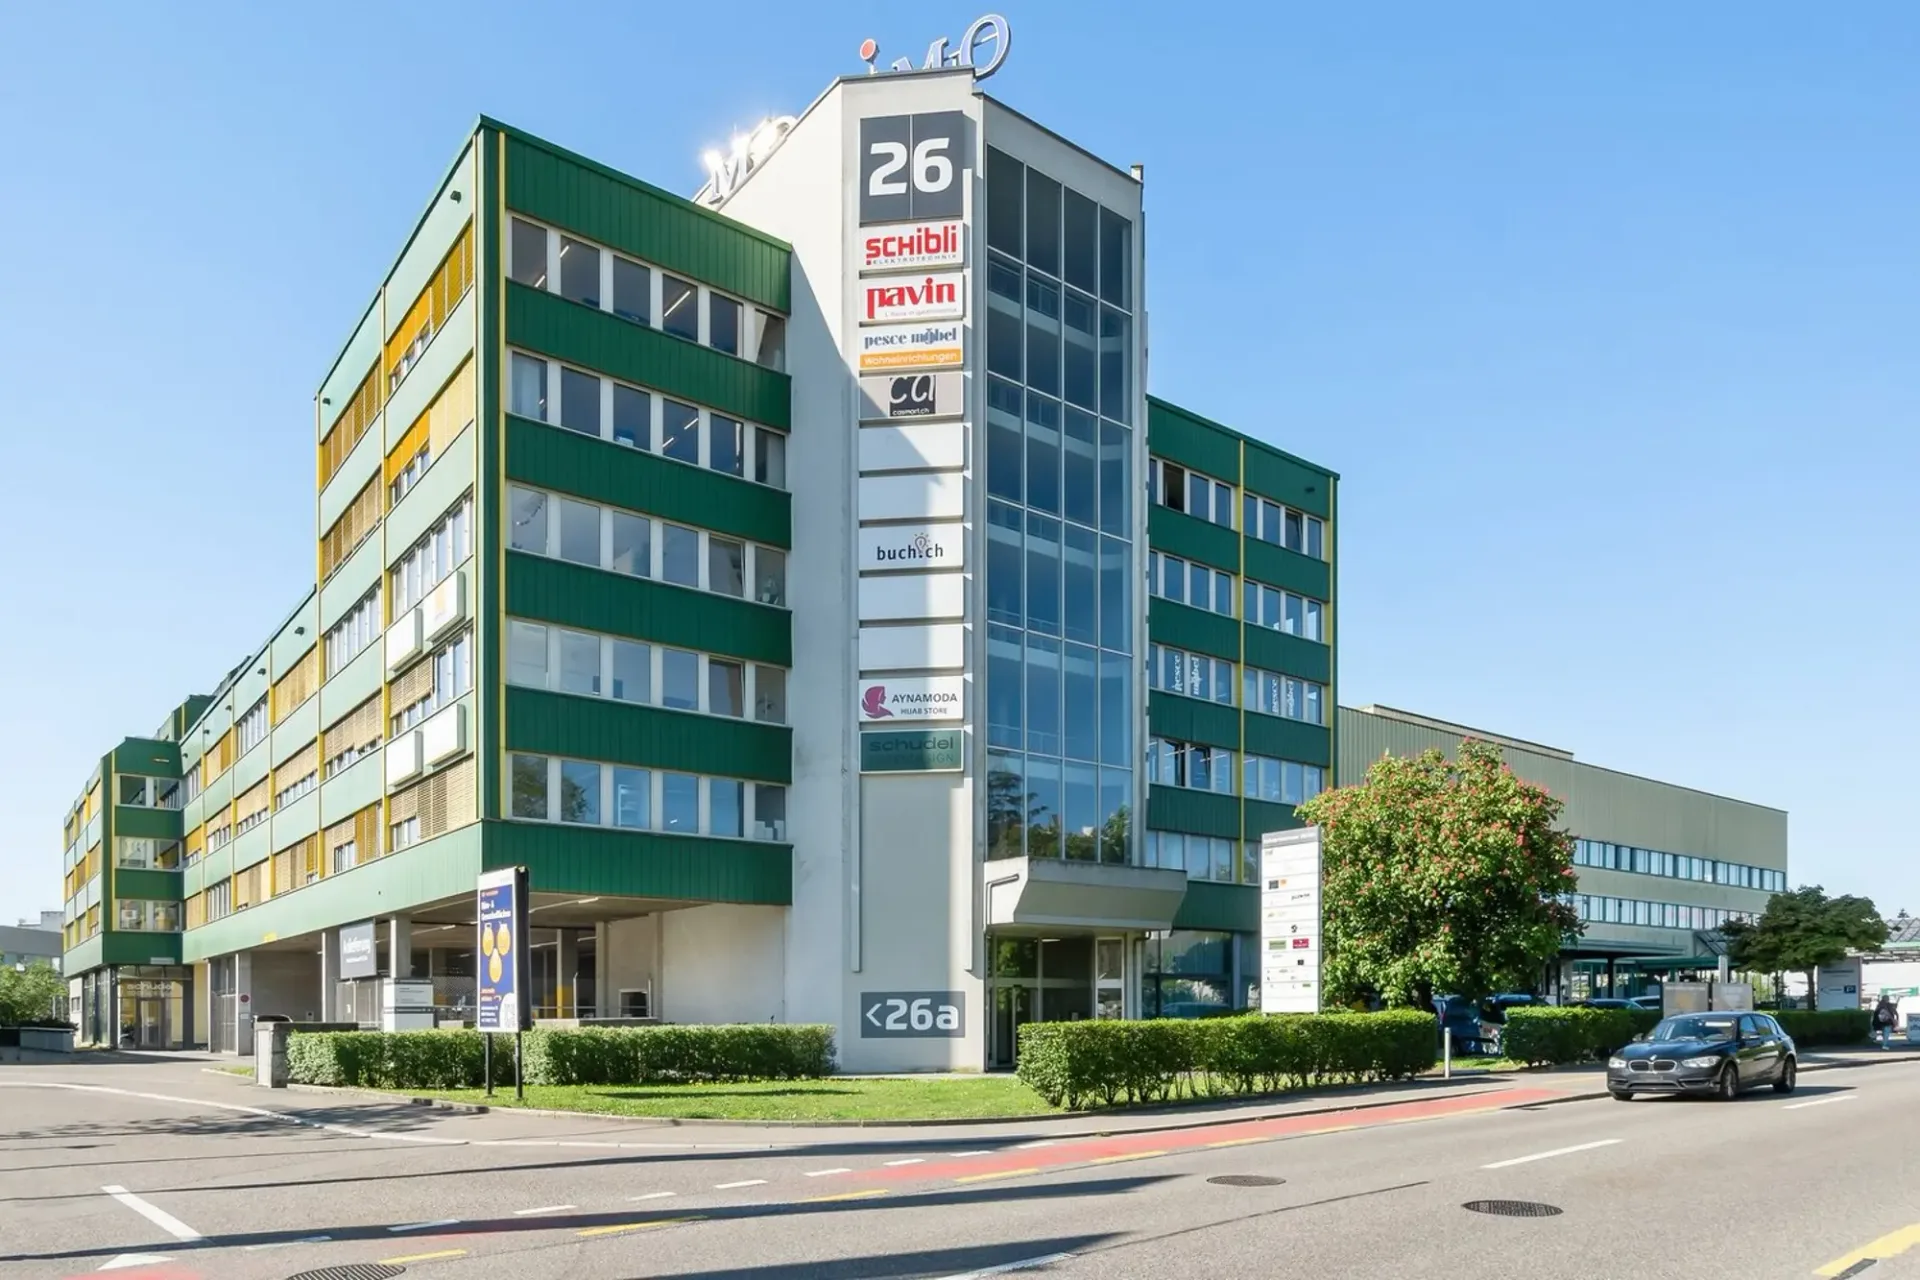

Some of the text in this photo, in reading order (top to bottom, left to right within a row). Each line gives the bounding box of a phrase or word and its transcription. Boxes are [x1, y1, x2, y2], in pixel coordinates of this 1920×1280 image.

[868, 138, 953, 196] 26
[867, 277, 956, 319] pavin
[864, 334, 907, 350] pesce
[877, 543, 944, 560] buch.ch
[892, 693, 957, 703] AYNAMODA
[869, 737, 954, 752] schudel
